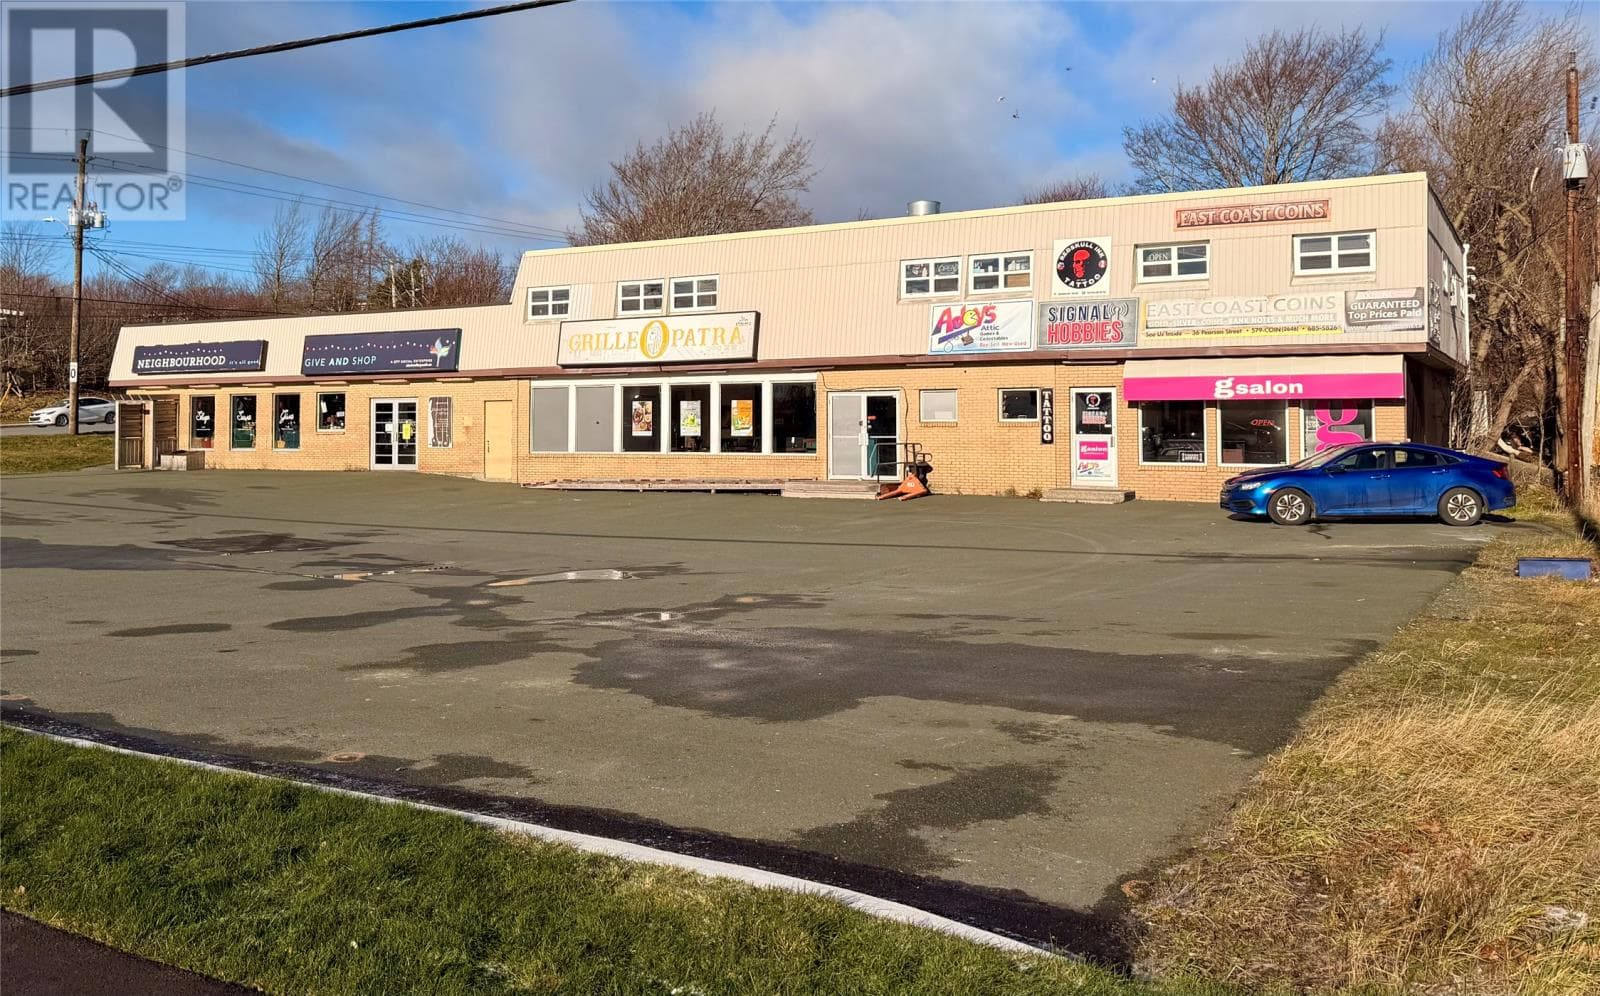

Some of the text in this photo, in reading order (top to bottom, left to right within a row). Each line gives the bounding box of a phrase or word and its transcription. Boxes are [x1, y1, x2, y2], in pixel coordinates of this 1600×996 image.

[1181, 203, 1324, 226] EAST COAST COINS
[1148, 253, 1168, 261] OPEN
[1064, 273, 1101, 288] TATTOO
[1147, 296, 1336, 317] EAST COAST COINS
[1350, 299, 1420, 310] GUARANTEED
[1048, 304, 1110, 322] SIGNAL
[1347, 308, 1422, 320] Top Prices Paid
[1047, 321, 1124, 345] HOBBIES
[137, 356, 226, 369] NEIGHBOURHOOD
[304, 355, 377, 367] GIVE AND SHOP
[1042, 391, 1051, 441] TATTOO
[1250, 418, 1275, 427] OPEN
